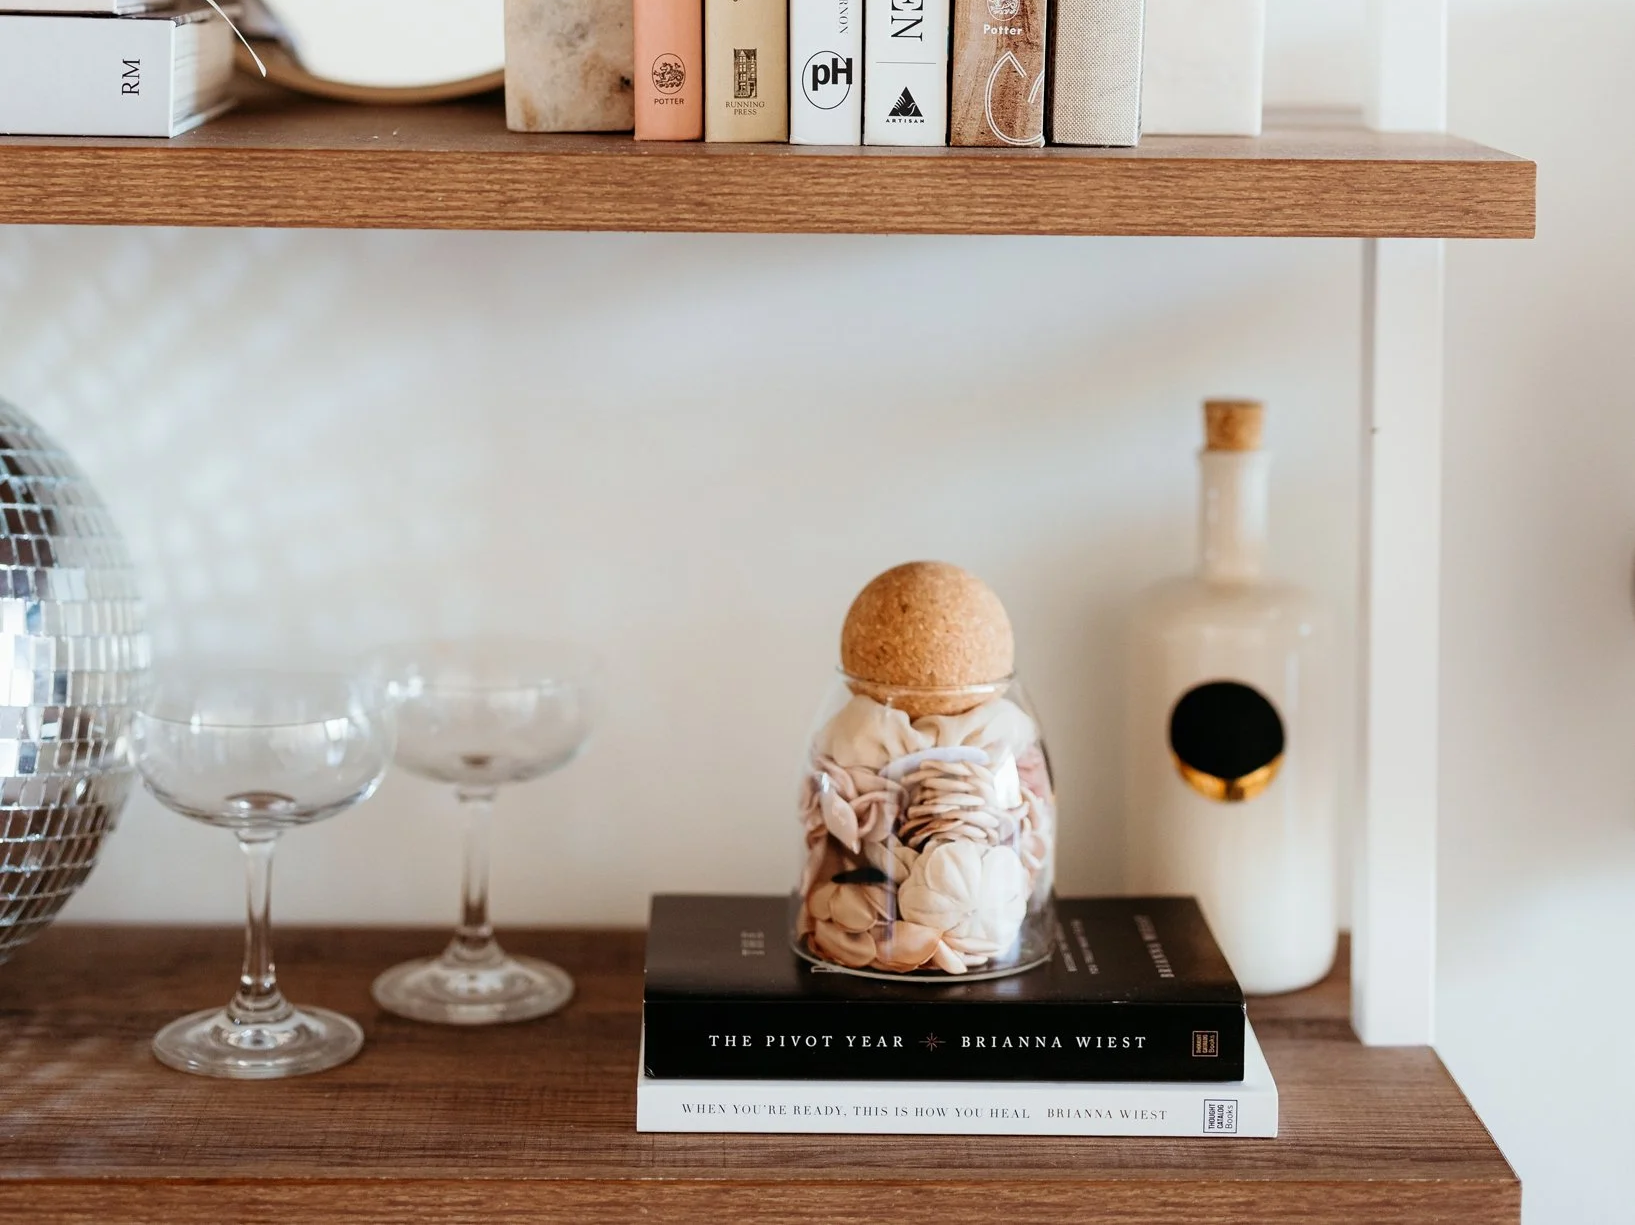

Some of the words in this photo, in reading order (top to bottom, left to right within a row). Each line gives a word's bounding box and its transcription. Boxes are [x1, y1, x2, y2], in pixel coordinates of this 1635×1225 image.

[983, 24, 1023, 36] Potter
[121, 59, 141, 96] RM
[812, 57, 853, 91] pH
[708, 1035, 752, 1047] THE
[766, 1035, 833, 1047] PIVOT
[846, 1035, 904, 1048] YEAR
[961, 1036, 1063, 1048] BRIANNA
[1076, 1036, 1146, 1048] WIEST
[682, 1104, 726, 1114] WHEN
[733, 1104, 787, 1115] YOU'RE
[793, 1105, 847, 1117] READY,
[853, 1106, 888, 1116] THIS
[895, 1106, 908, 1116] IS
[915, 1107, 948, 1117] HOW
[955, 1107, 983, 1118] YOU
[990, 1108, 1030, 1119] HEAL
[1047, 1108, 1112, 1119] BRIANNA
[1120, 1109, 1167, 1120] WIEST
[1225, 1104, 1233, 1129] Books
